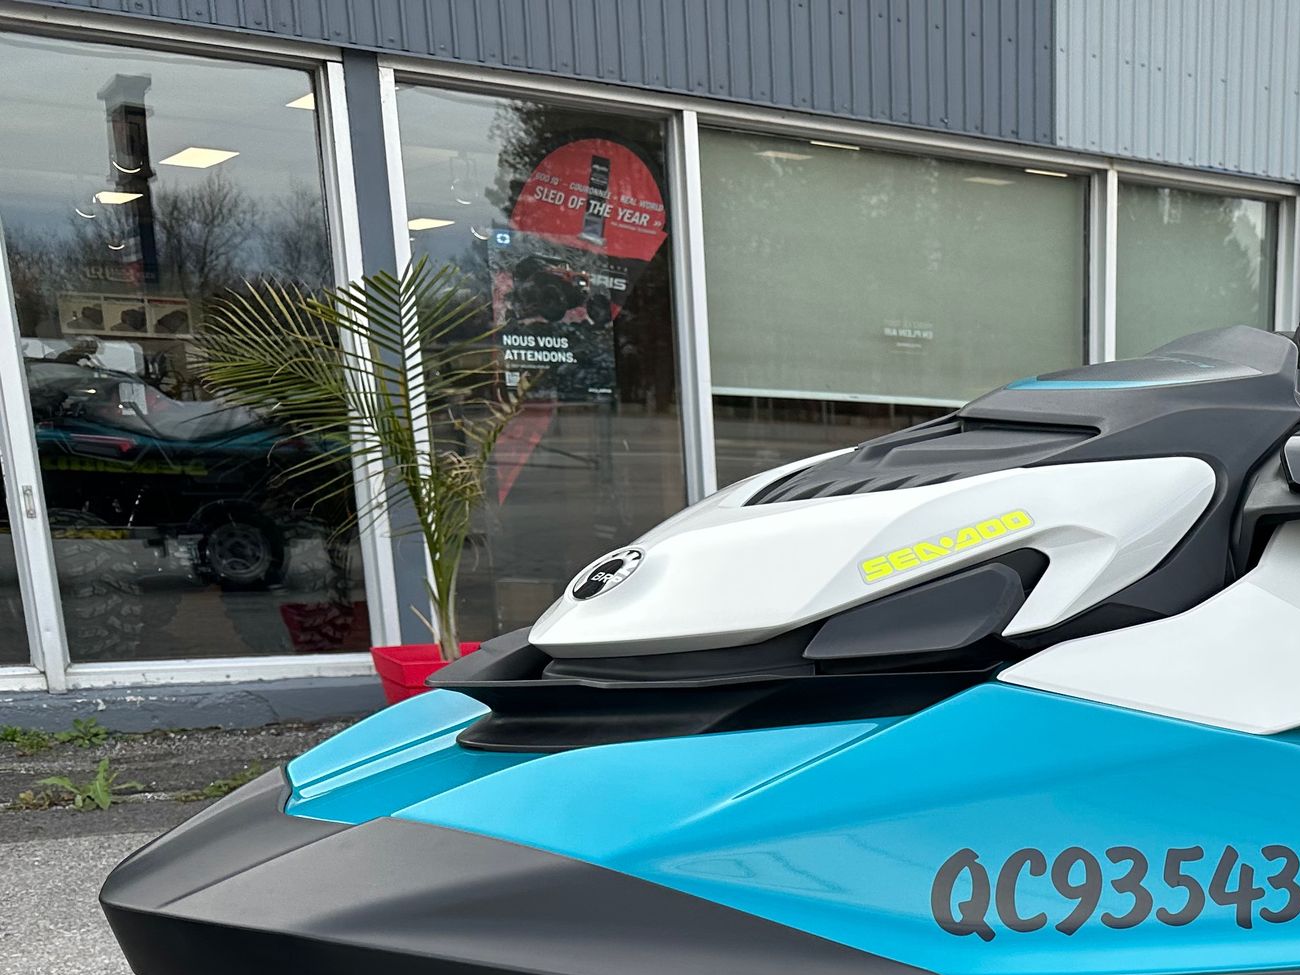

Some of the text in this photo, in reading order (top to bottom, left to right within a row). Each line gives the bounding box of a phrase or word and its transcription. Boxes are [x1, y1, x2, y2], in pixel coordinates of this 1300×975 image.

[533, 186, 650, 226] SLED OF THE YEAR
[502, 335, 569, 348] NOUS VOUS
[504, 350, 578, 363] ATTENDONS.
[590, 571, 623, 584] BRP
